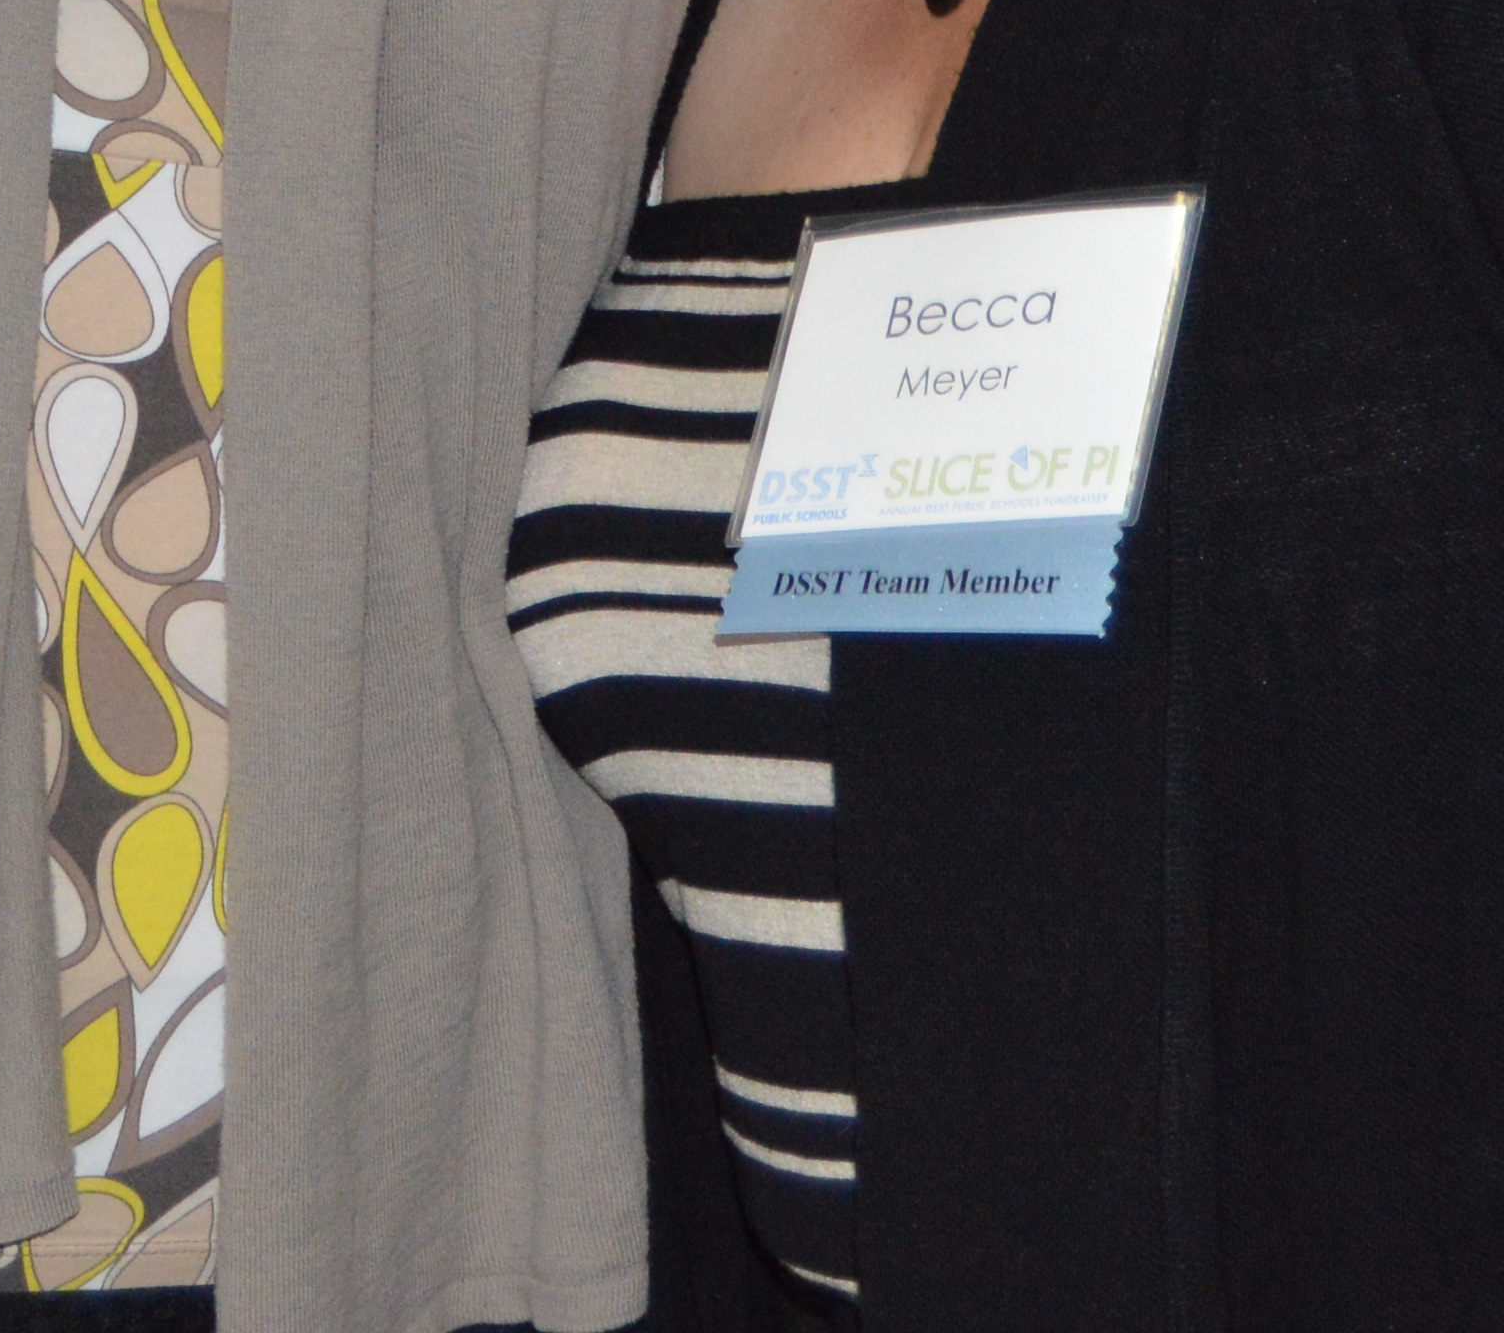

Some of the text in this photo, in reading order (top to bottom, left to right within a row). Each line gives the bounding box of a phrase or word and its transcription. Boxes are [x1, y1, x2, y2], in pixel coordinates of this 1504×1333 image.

[885, 291, 1057, 339] Becca
[896, 364, 1019, 402] Meyer
[757, 464, 857, 506] DSST
[884, 444, 1120, 501] SLICE OF PI
[752, 507, 848, 525] PUBLIC SCHOOLS
[878, 505, 922, 517] ANNUAL
[924, 503, 950, 514] DSST
[951, 501, 985, 513] PUBLIC
[989, 497, 1041, 511] SCHOOLS
[772, 567, 1061, 597] DSST Team Member
